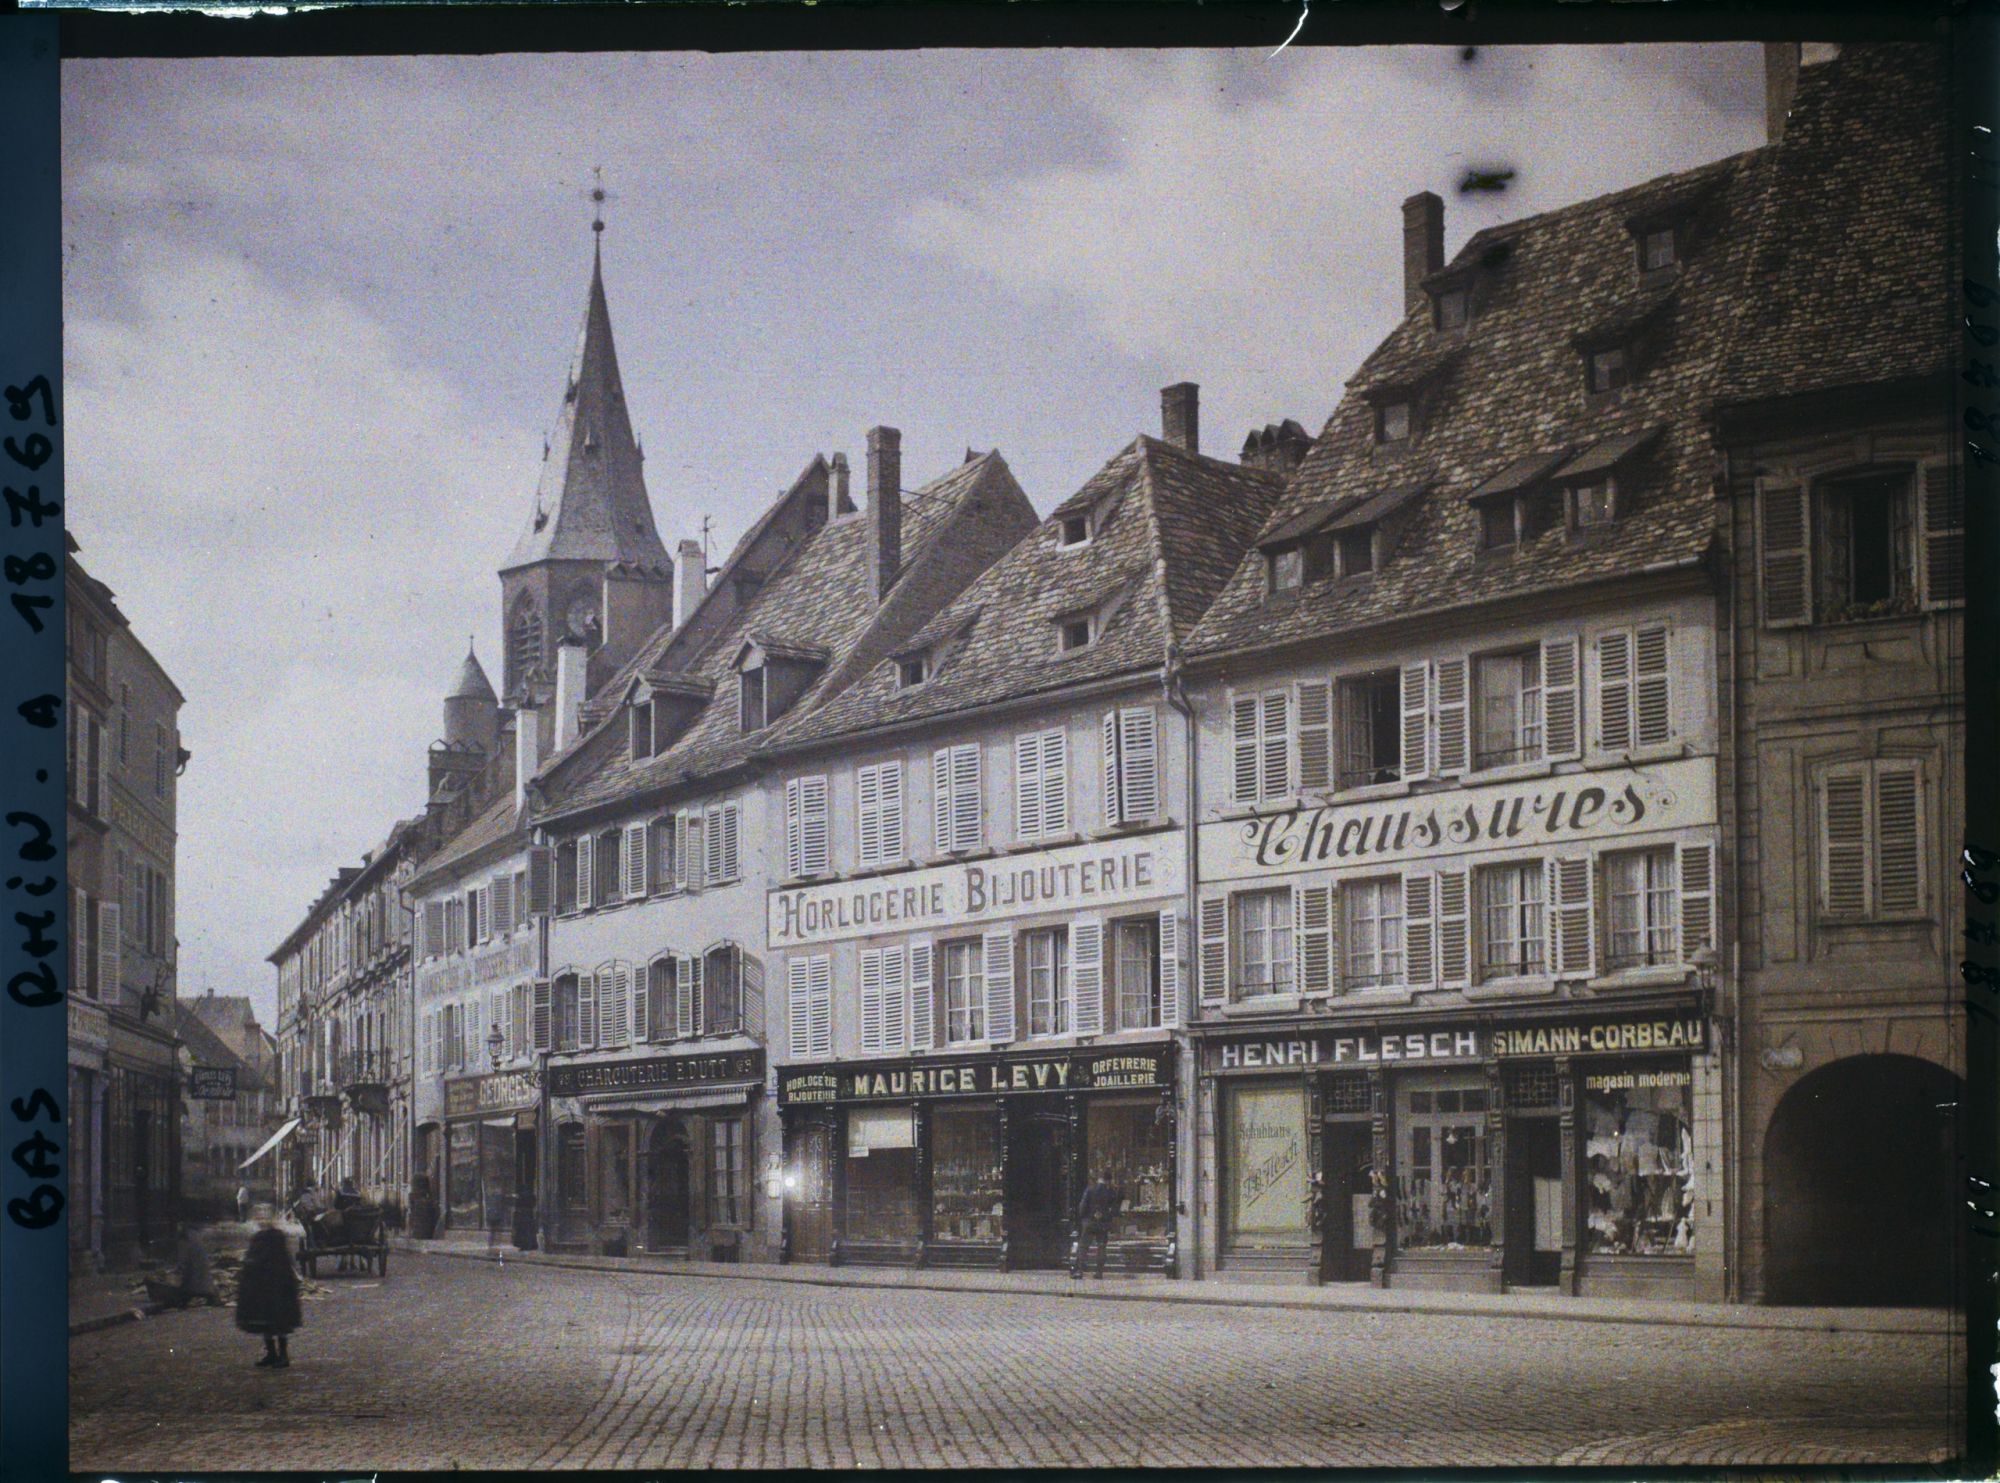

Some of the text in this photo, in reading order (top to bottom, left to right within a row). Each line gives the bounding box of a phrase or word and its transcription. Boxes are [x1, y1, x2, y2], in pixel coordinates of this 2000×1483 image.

[3, 374, 60, 634] 18769
[17, 693, 62, 729] A
[1241, 784, 1646, 867] Chaussures
[777, 851, 1154, 939] HORLOGERIE BIJOUTERIE
[1221, 1030, 1477, 1068] HENRI FLESCH
[1492, 1019, 1704, 1056] SIMANN-CORBEAU
[577, 1063, 669, 1088] CHARCUTERIE
[854, 1061, 1072, 1097] MAURICE LEVY
[1092, 1057, 1158, 1075] ORFEVRERIE
[1093, 1073, 1156, 1087] JOAILLERIE
[1586, 1071, 1692, 1095] magasin moderne
[7, 1087, 65, 1230] BAS
